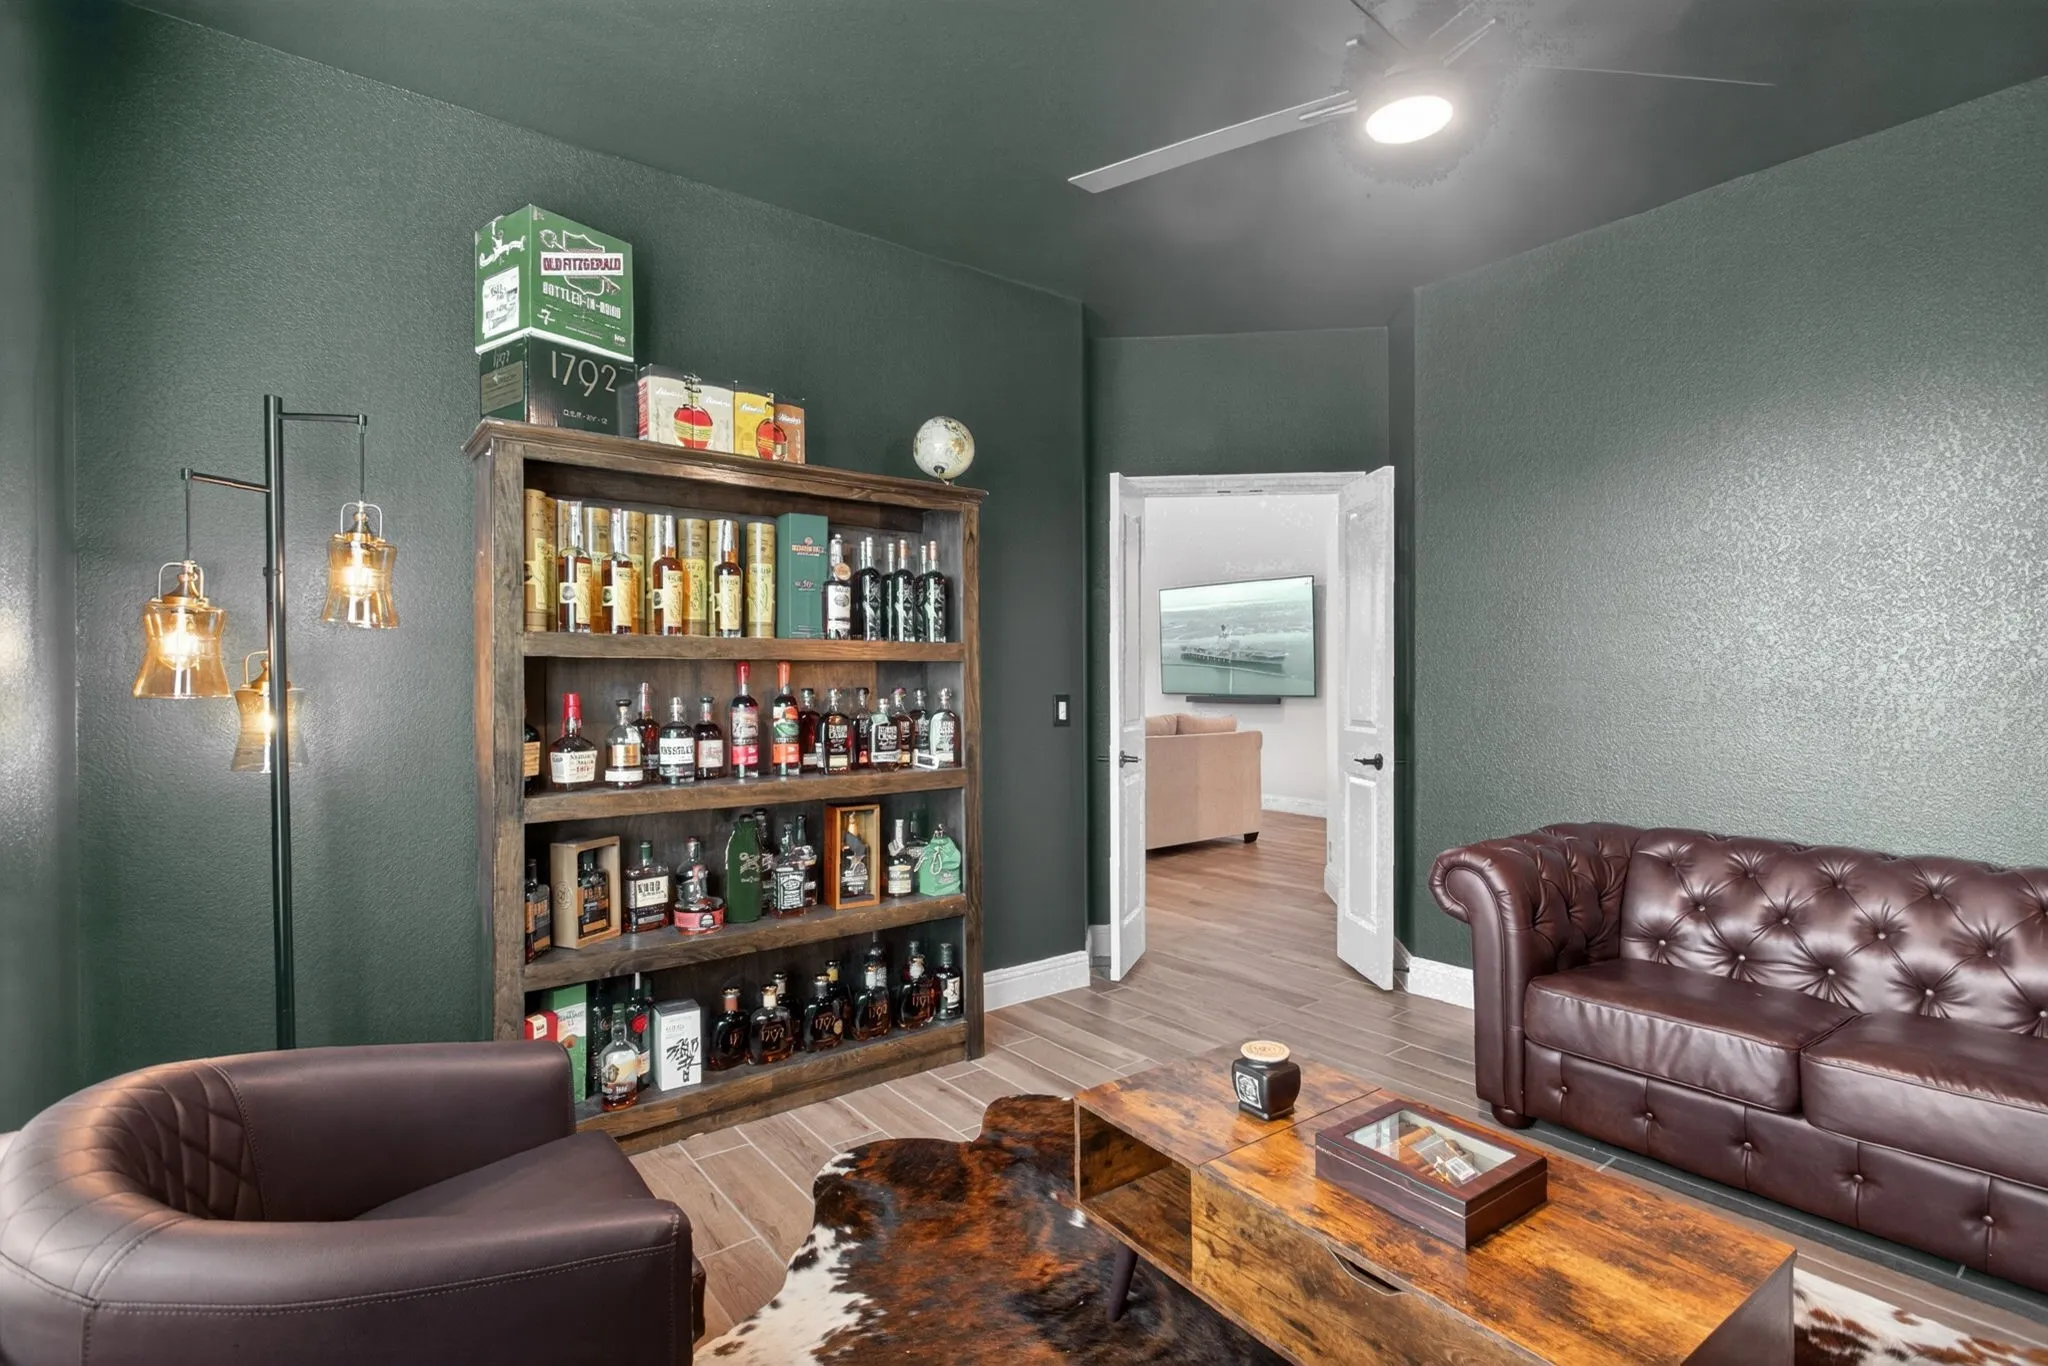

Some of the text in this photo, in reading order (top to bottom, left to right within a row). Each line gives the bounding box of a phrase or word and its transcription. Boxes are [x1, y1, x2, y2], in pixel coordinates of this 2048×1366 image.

[543, 257, 621, 271] OLD FITZGERALD
[551, 350, 617, 397] 1792
